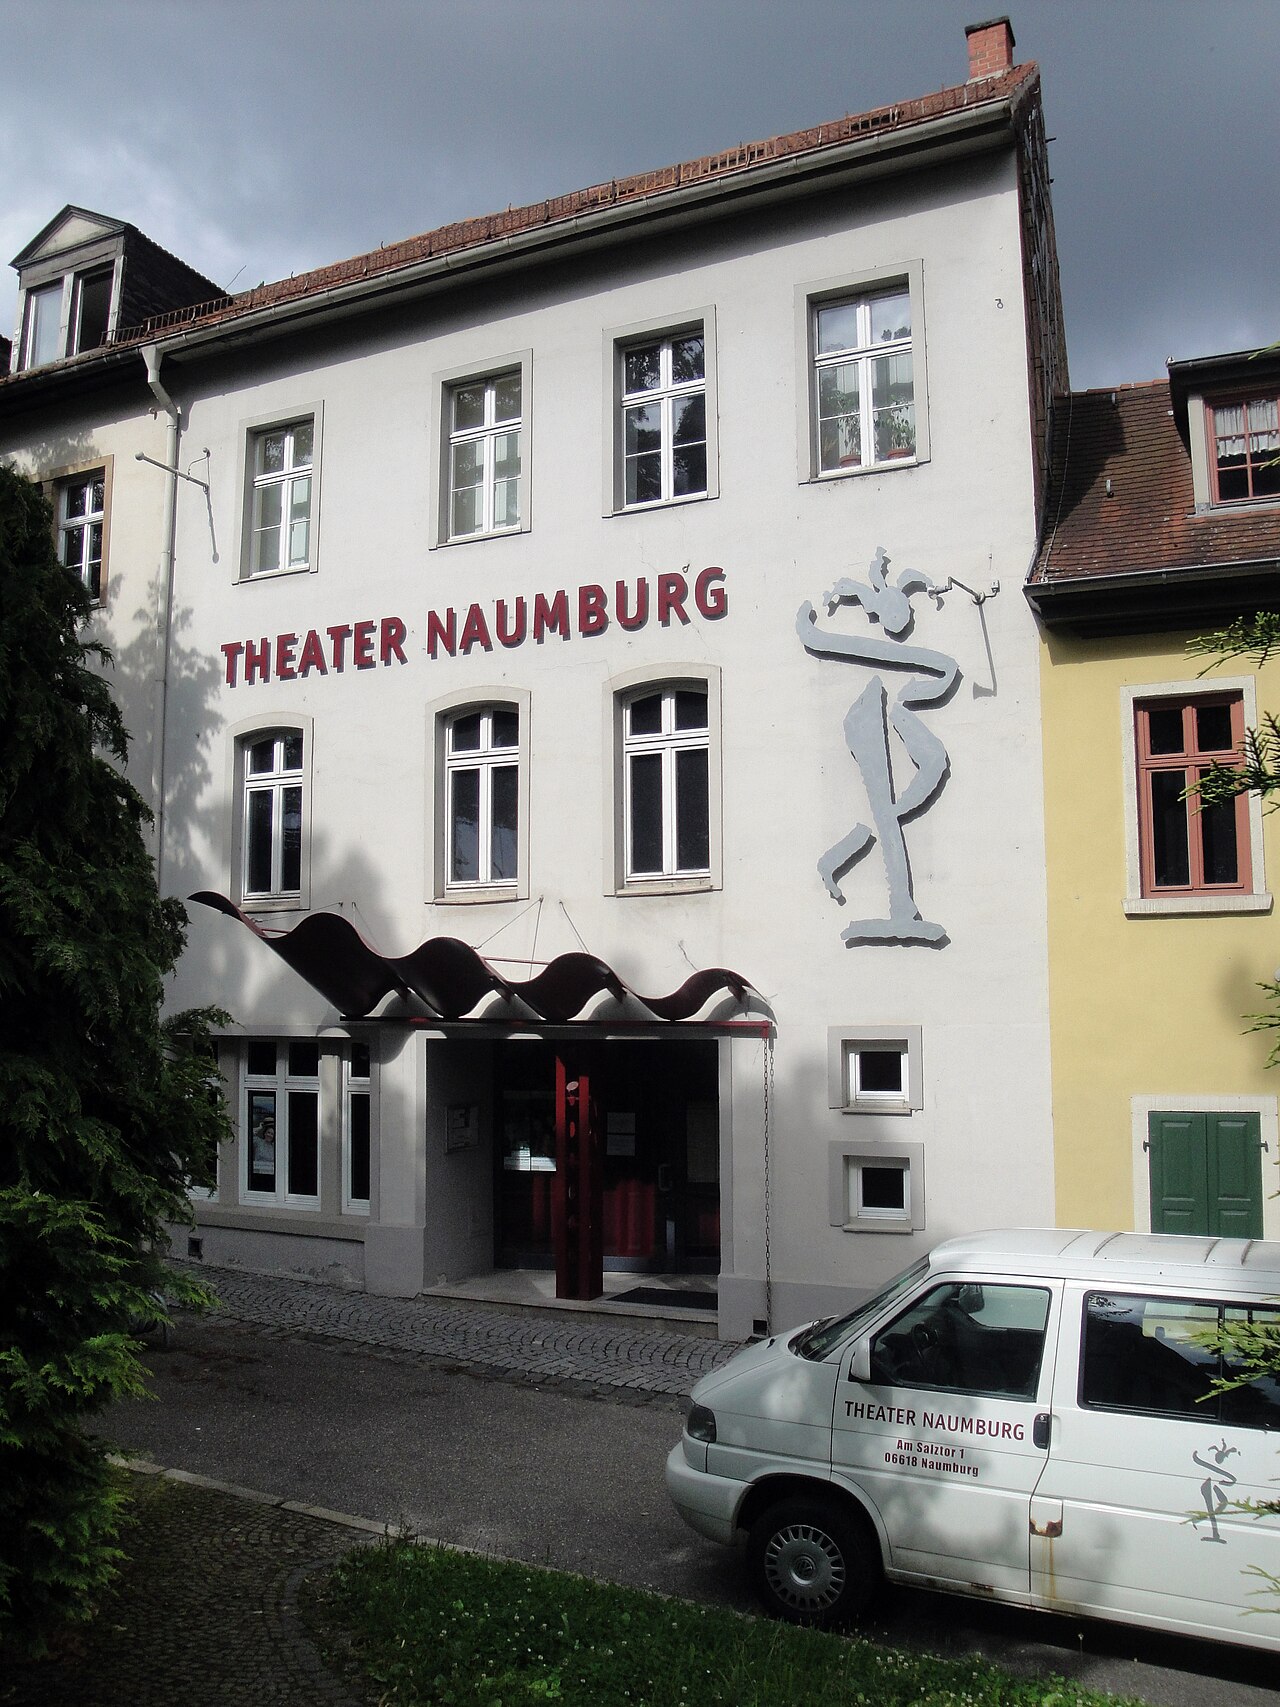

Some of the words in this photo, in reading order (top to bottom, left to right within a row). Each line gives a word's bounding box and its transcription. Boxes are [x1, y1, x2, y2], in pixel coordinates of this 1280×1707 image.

[221, 617, 406, 687] THEATER
[426, 567, 727, 658] NAUMBURG
[845, 1401, 916, 1426] THEATER
[922, 1412, 1025, 1440] NAUMBURG
[884, 1452, 918, 1467] 06618
[921, 1458, 979, 1477] Naumburg
[896, 1439, 913, 1451] Am
[916, 1442, 956, 1458] Salztor
[959, 1448, 965, 1459] 1
